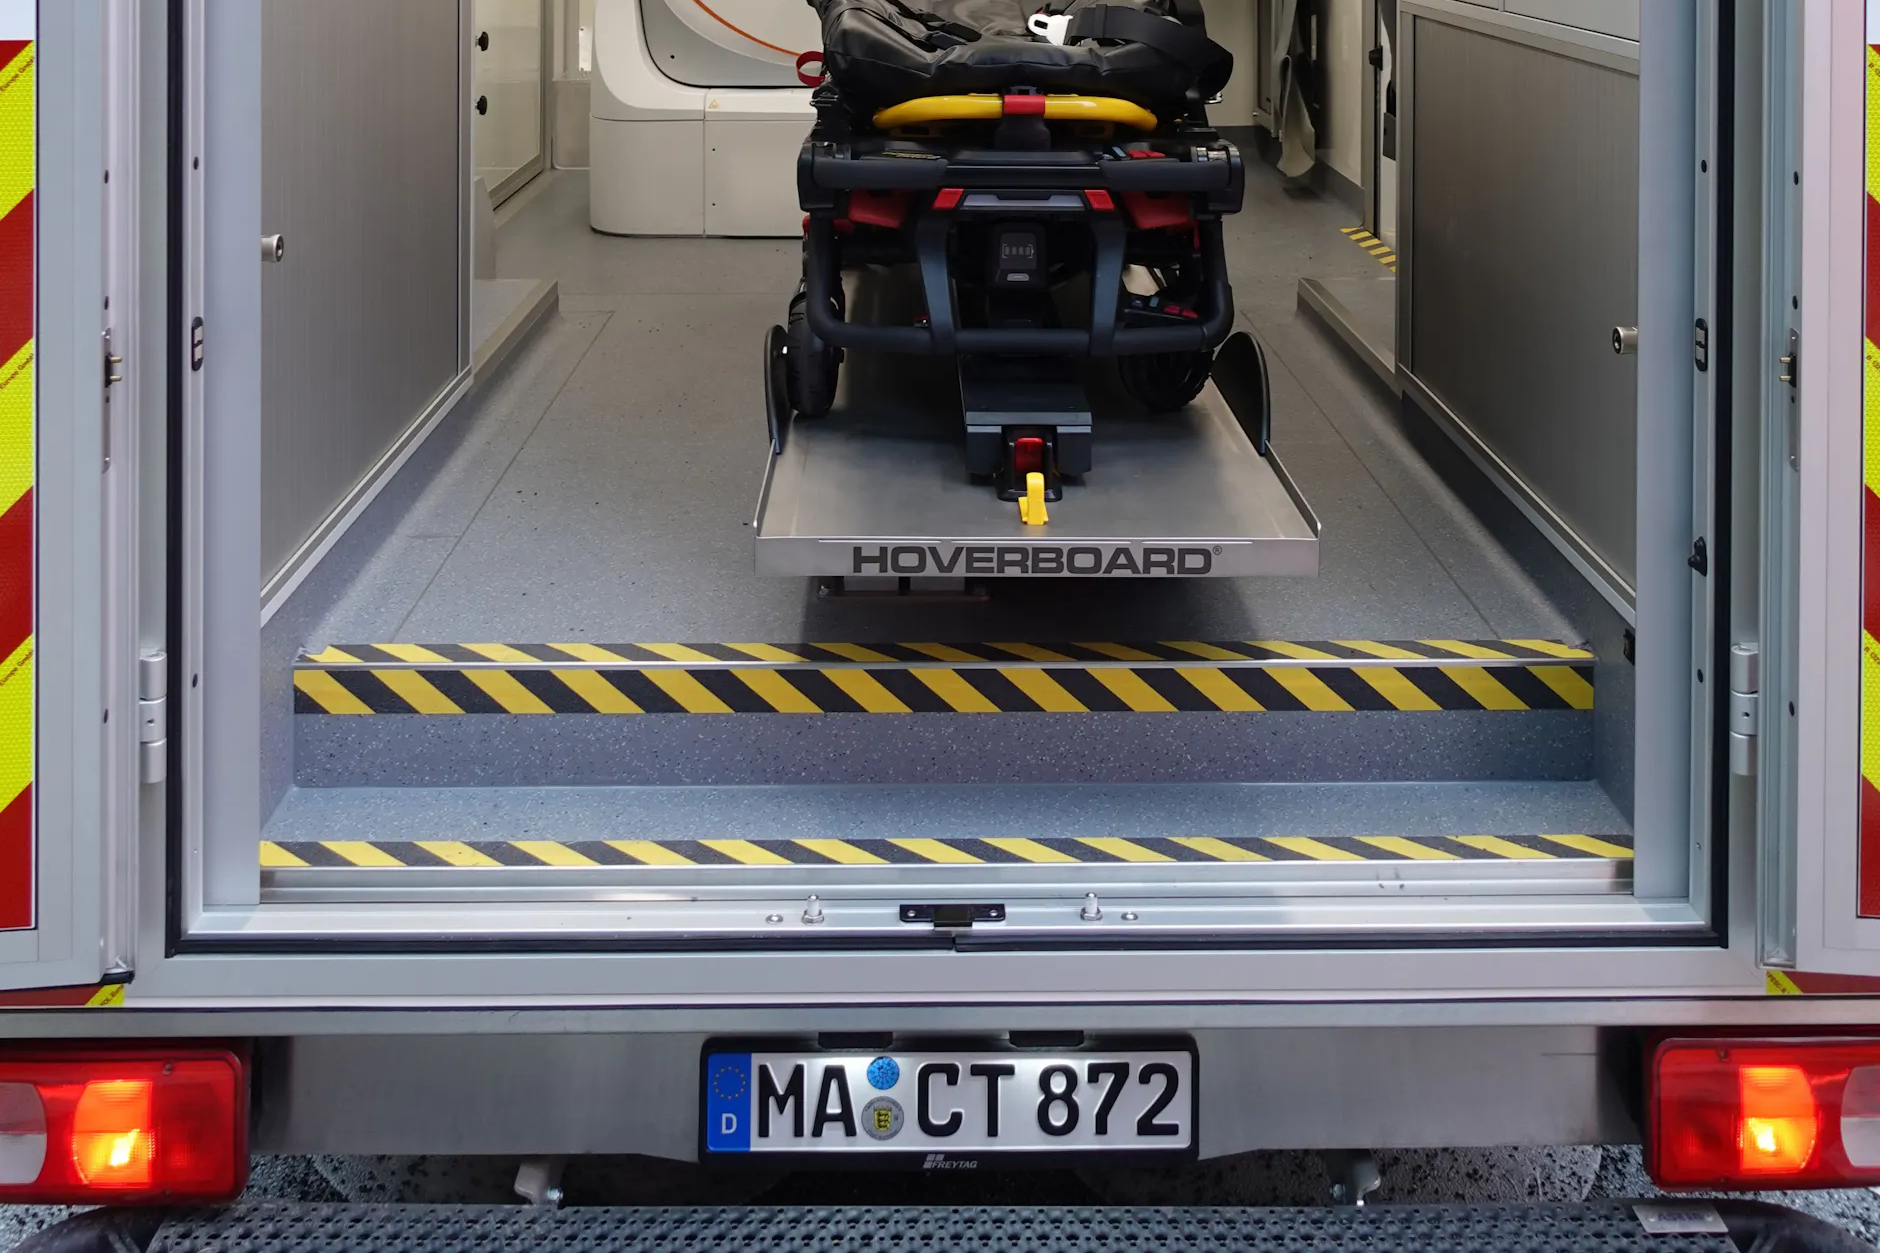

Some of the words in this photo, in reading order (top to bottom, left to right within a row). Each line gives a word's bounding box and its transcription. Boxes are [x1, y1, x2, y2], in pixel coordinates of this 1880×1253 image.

[757, 1063, 858, 1138] MA
[916, 1062, 1016, 1138] CT
[1036, 1061, 1180, 1137] 872
[721, 1112, 738, 1135] D
[931, 1160, 978, 1169] FREYTAG
